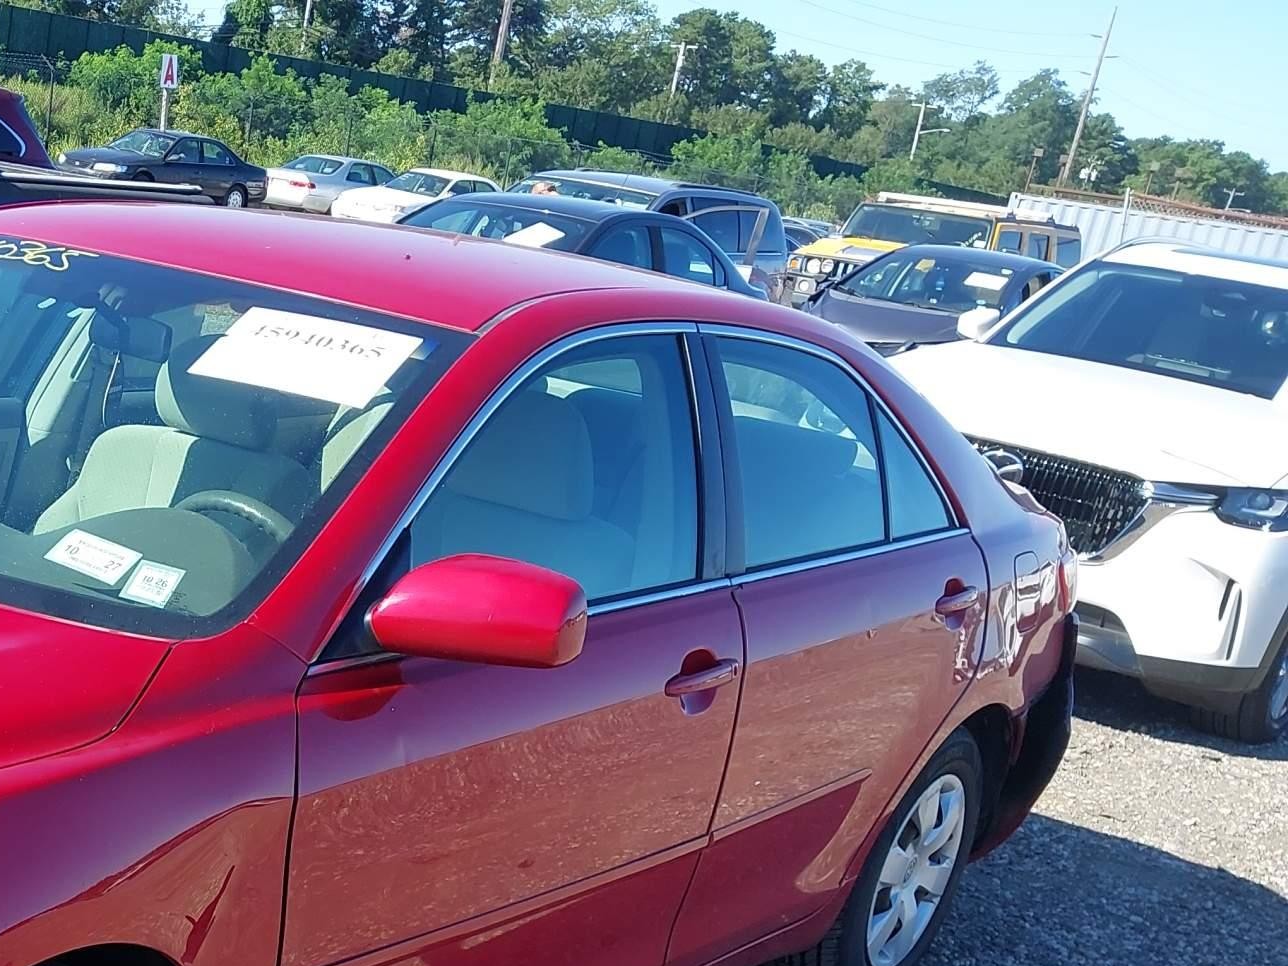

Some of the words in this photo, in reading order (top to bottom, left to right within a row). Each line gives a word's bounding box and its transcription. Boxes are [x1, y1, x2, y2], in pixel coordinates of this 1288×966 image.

[163, 55, 175, 85] A
[64, 544, 80, 555] 10
[103, 560, 123, 571] 27
